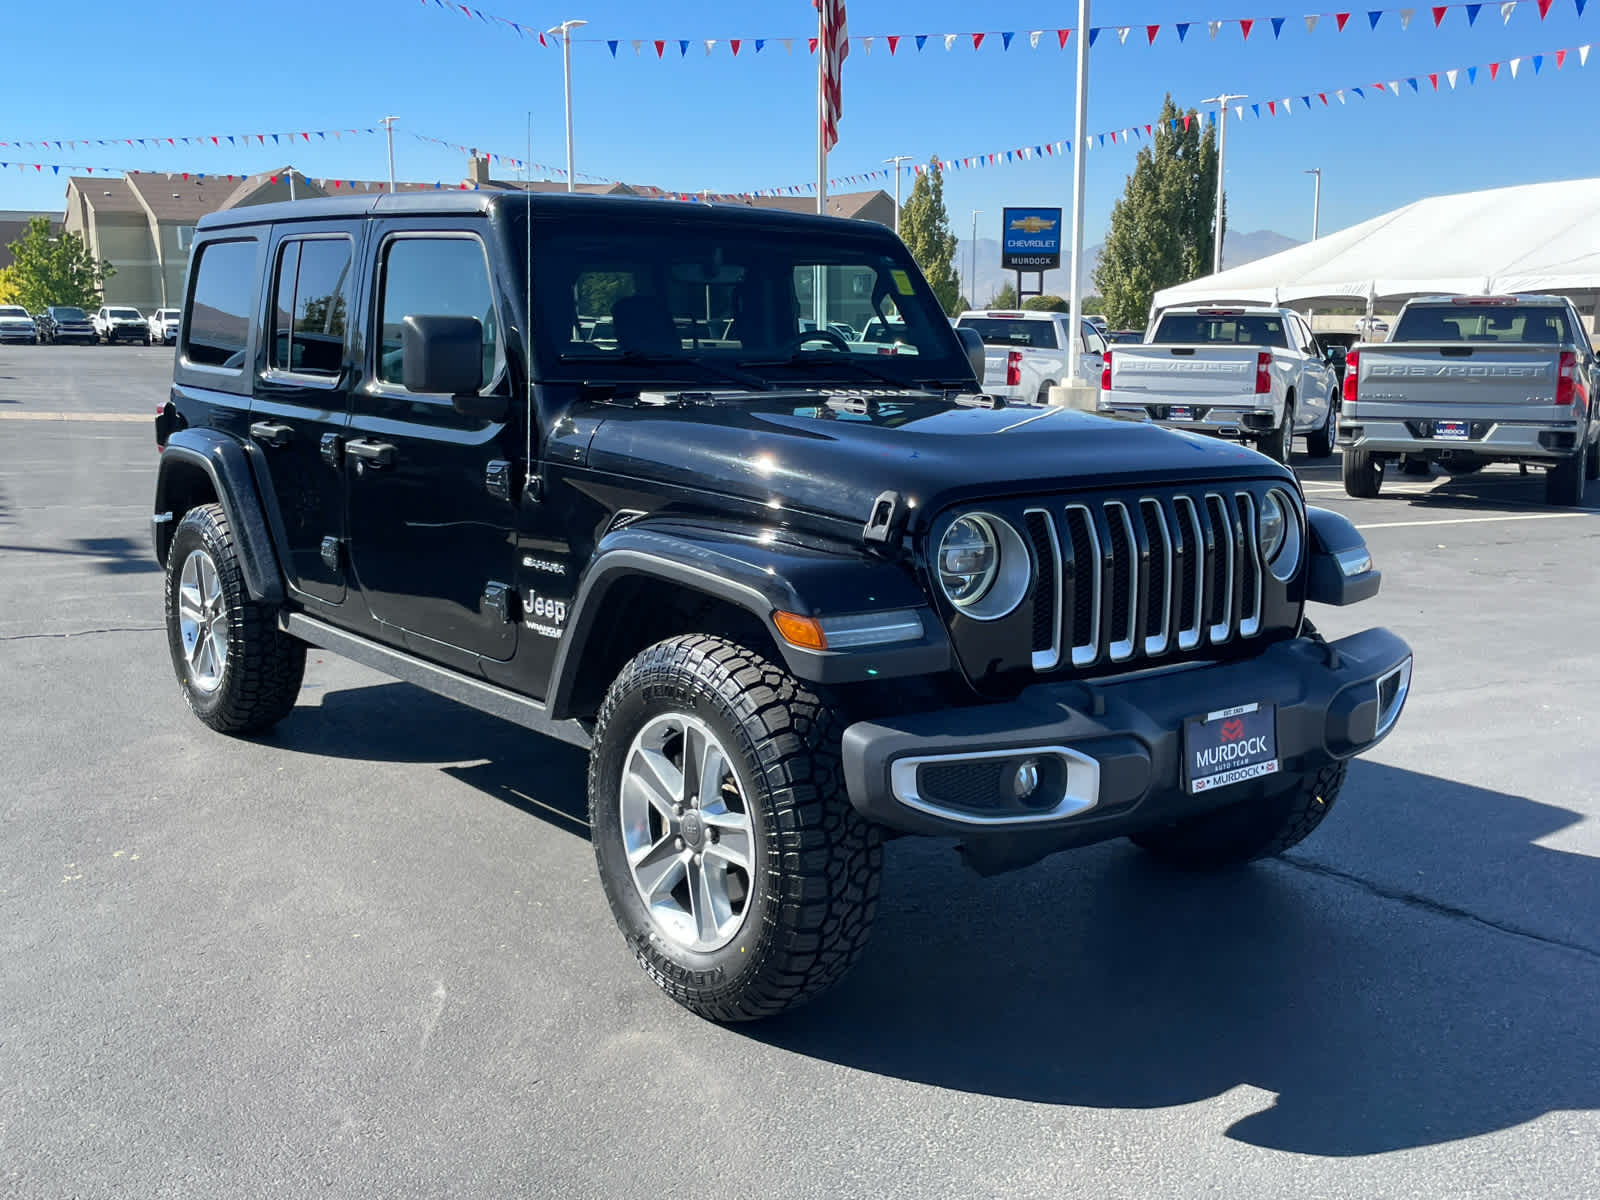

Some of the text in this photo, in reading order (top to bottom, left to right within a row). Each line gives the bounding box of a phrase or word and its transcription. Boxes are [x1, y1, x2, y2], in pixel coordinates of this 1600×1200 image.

[1007, 239, 1056, 248] CHEVROLET
[1011, 257, 1051, 265] MURDOCK
[1371, 366, 1545, 377] CHEVROLET
[523, 589, 566, 625] Jeep
[1196, 735, 1267, 768] MURDOCK
[1215, 758, 1249, 772] AUTO TEAM
[1213, 765, 1260, 785] MURDOCK
